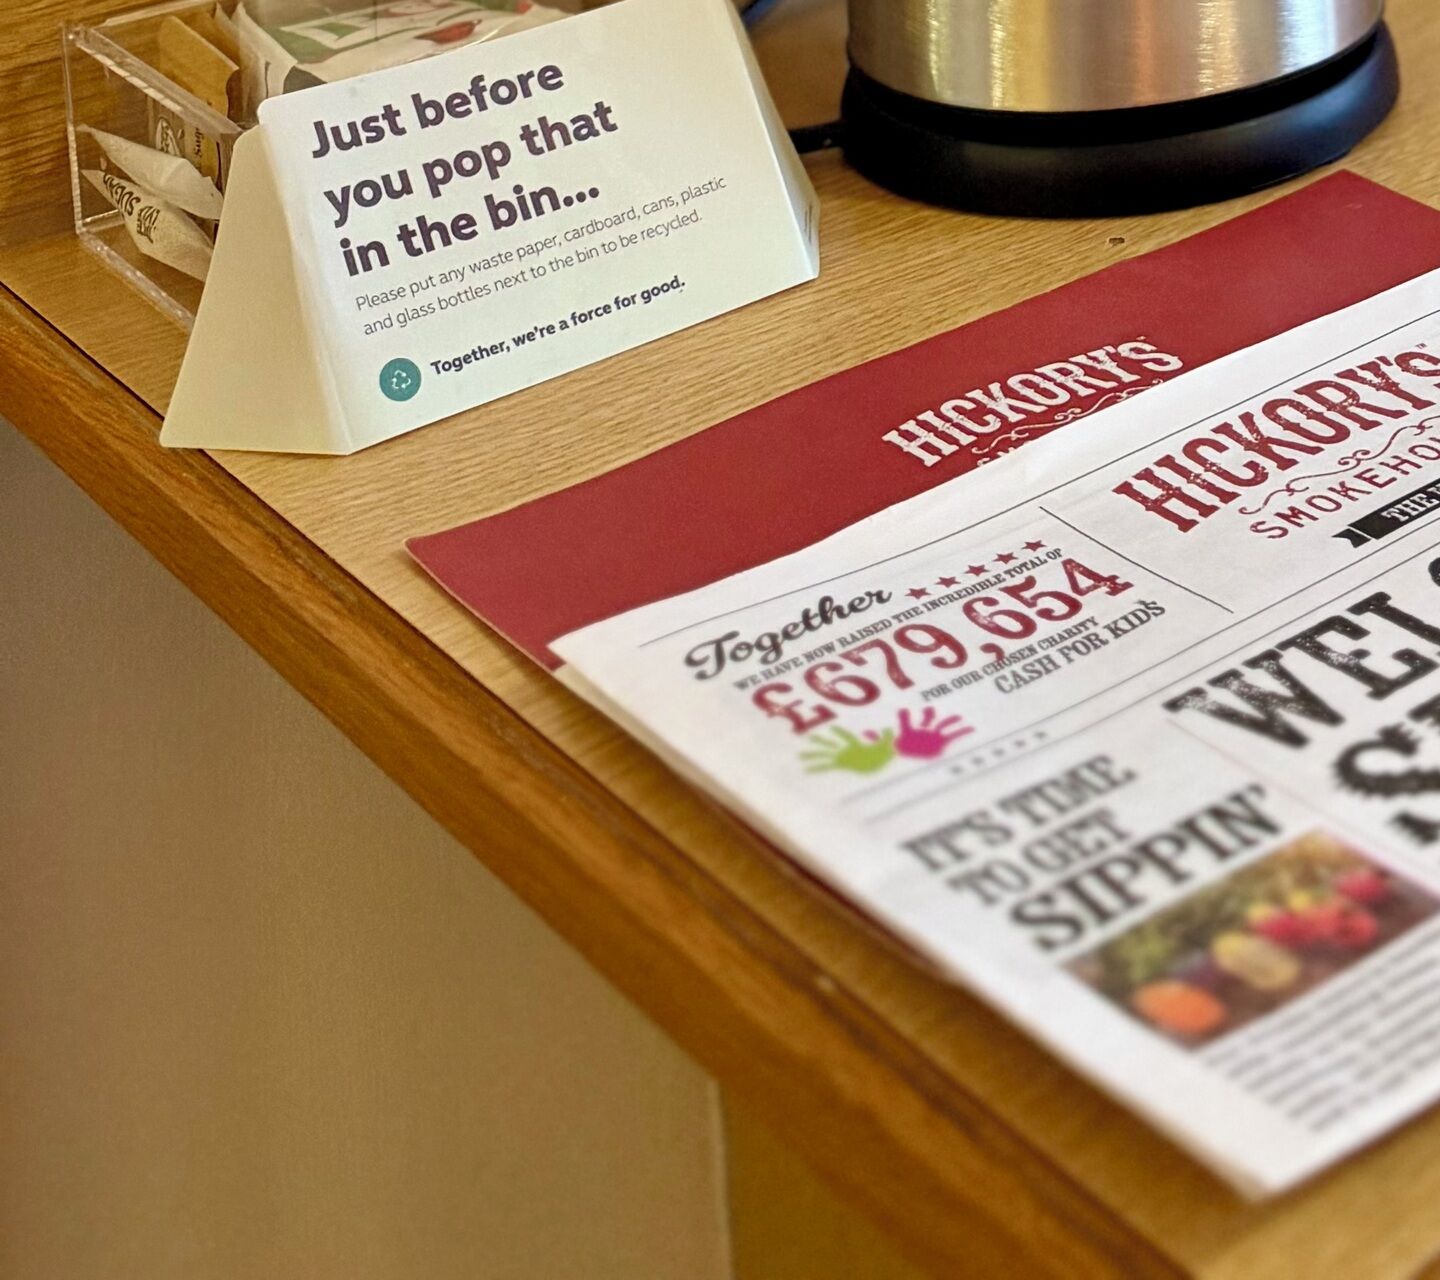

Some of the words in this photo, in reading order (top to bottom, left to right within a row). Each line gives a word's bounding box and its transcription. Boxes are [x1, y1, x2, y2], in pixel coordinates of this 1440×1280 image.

[311, 105, 406, 159] Just
[410, 63, 564, 130] before
[323, 168, 412, 227] you
[422, 140, 512, 198] pop
[520, 101, 619, 156] that
[339, 238, 390, 276] in
[397, 208, 478, 258] the
[484, 182, 600, 231] bin...
[355, 282, 407, 311] Please
[410, 274, 437, 299] put
[438, 263, 468, 290] any
[468, 248, 514, 274] waste
[516, 233, 561, 262] paper,
[564, 208, 641, 244] cardboard,
[643, 193, 679, 217] cans,
[680, 176, 727, 205] plastic
[363, 319, 395, 336] and
[396, 303, 437, 329] glass
[438, 281, 492, 312] bottles
[493, 271, 528, 292] next
[530, 263, 547, 279] to
[549, 254, 575, 274] the
[576, 244, 600, 264] bin
[601, 238, 618, 254] to
[619, 230, 639, 247] be
[641, 209, 703, 242] recycled.
[430, 338, 511, 375] Together,
[511, 321, 557, 348] we're
[558, 317, 570, 332] a
[571, 301, 613, 327] force
[613, 292, 638, 313] for
[640, 274, 686, 308] good.
[882, 338, 1186, 469] HICKORY'S
[1381, 493, 1440, 522] THE
[684, 585, 893, 681] Together
[733, 676, 763, 691] WE
[762, 658, 804, 683] HAVE
[802, 642, 838, 663] NOW
[836, 619, 894, 650] RAISED
[893, 605, 924, 625] THE
[924, 573, 1007, 614] INCREDIBLE
[1003, 555, 1050, 583] TOTAL
[1045, 547, 1063, 561] OF
[751, 555, 1135, 737] £679,654
[921, 687, 954, 702] FOR
[951, 669, 983, 691] OUR
[982, 646, 1038, 680] CHOSEN
[1037, 616, 1099, 650] CHARITY
[993, 659, 1062, 694] CASH
[1056, 632, 1110, 664] FOR
[901, 806, 1012, 874] IT'S
[997, 754, 1138, 830] TIME
[948, 860, 1030, 907] TO
[1020, 808, 1137, 874] GET
[1007, 781, 1288, 952] SIPPIN'
